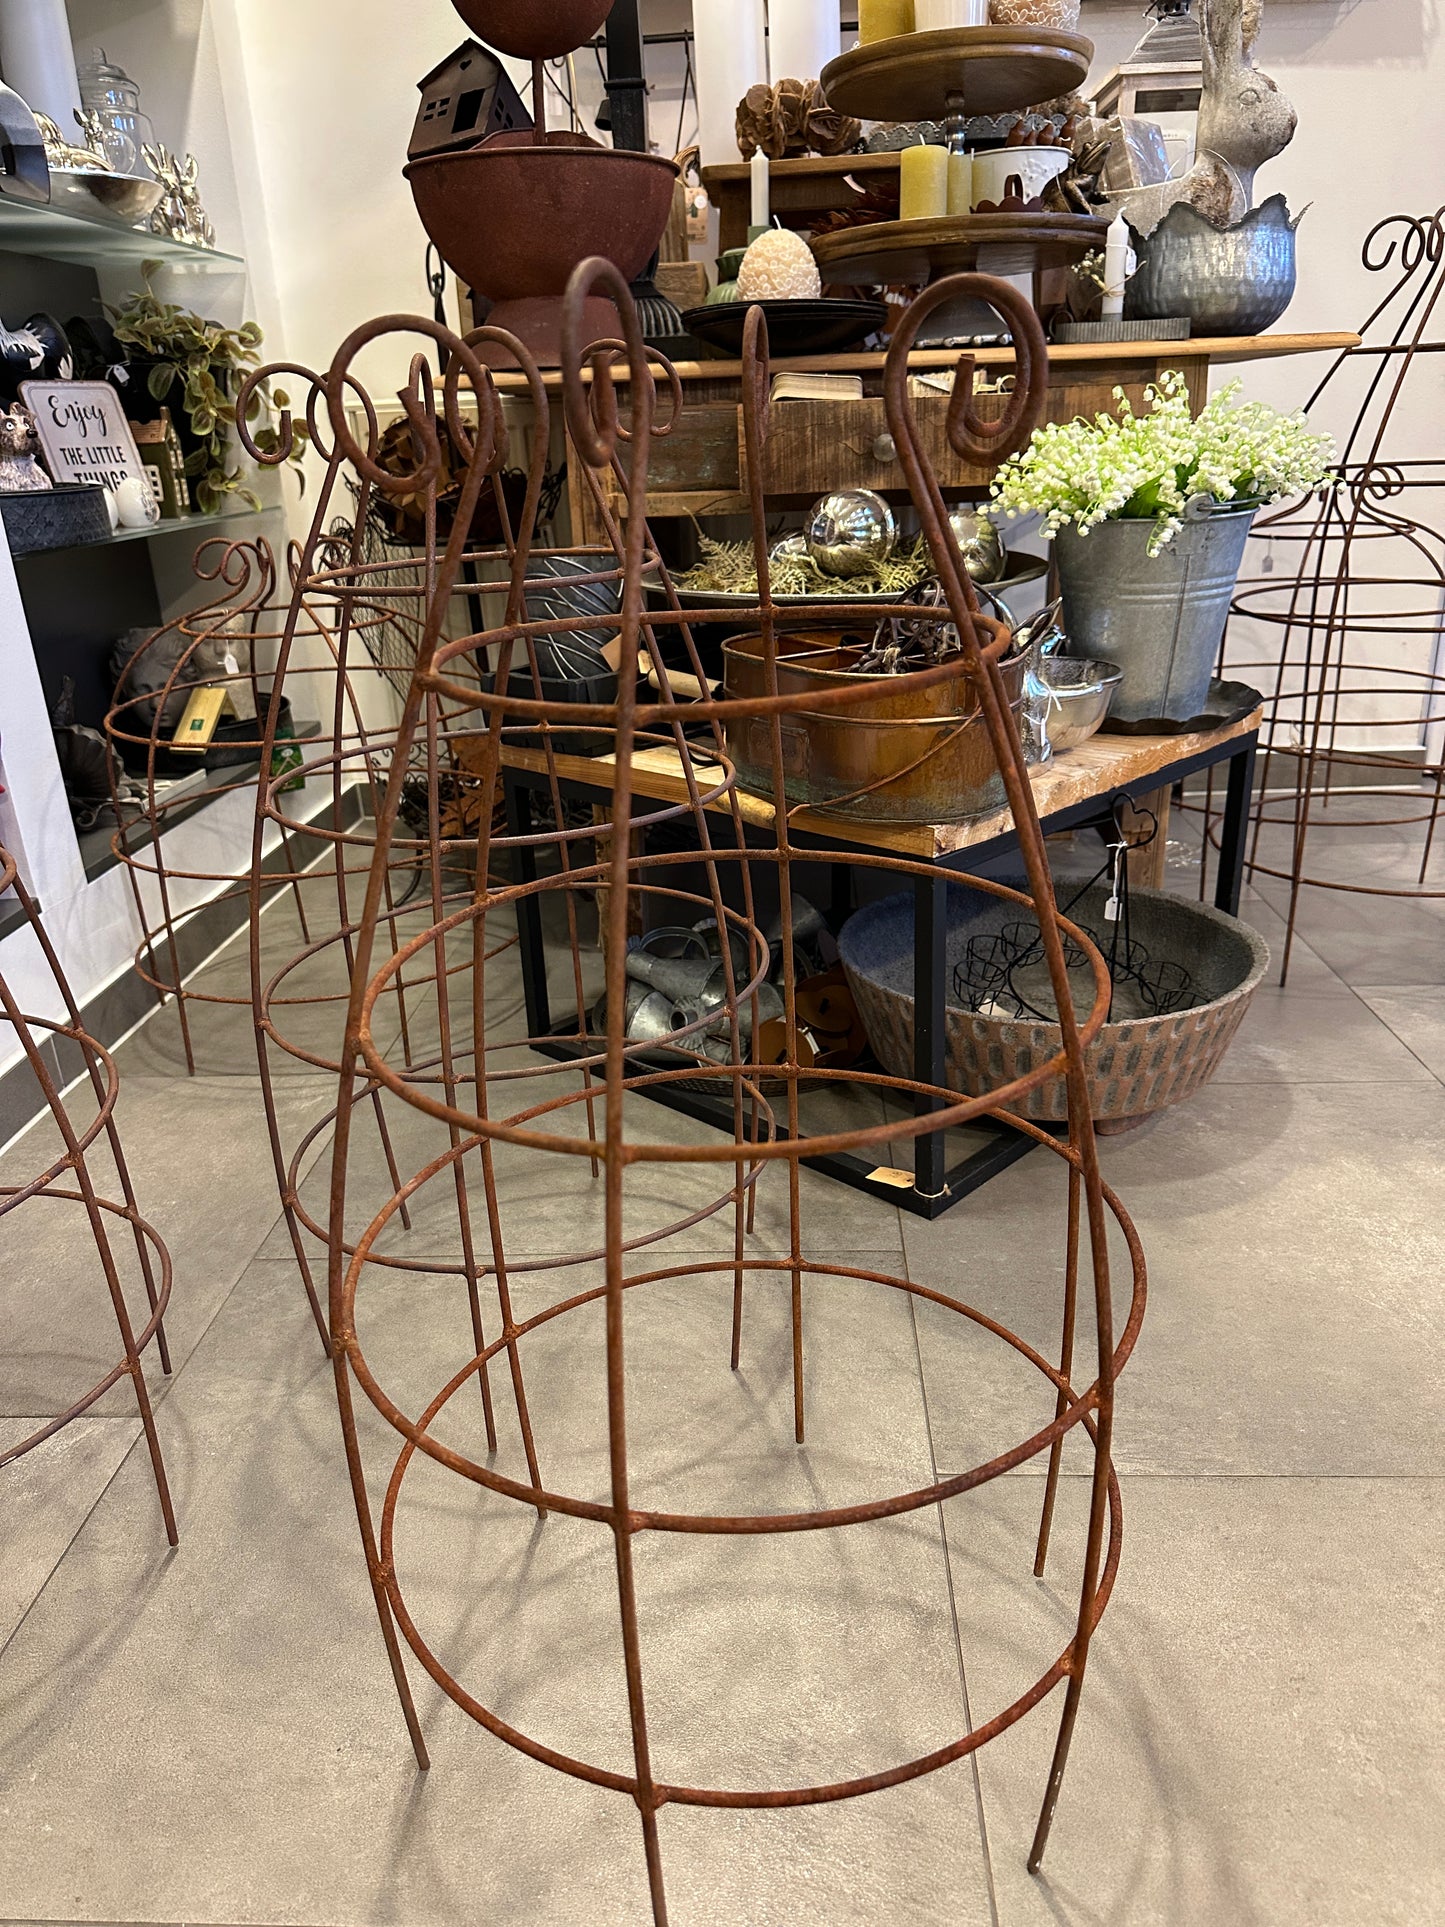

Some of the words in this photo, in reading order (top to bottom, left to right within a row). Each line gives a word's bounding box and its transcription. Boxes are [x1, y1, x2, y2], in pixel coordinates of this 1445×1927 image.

[48, 395, 107, 438] Enjoy
[59, 447, 86, 466] THE
[86, 446, 127, 464] LITTLE
